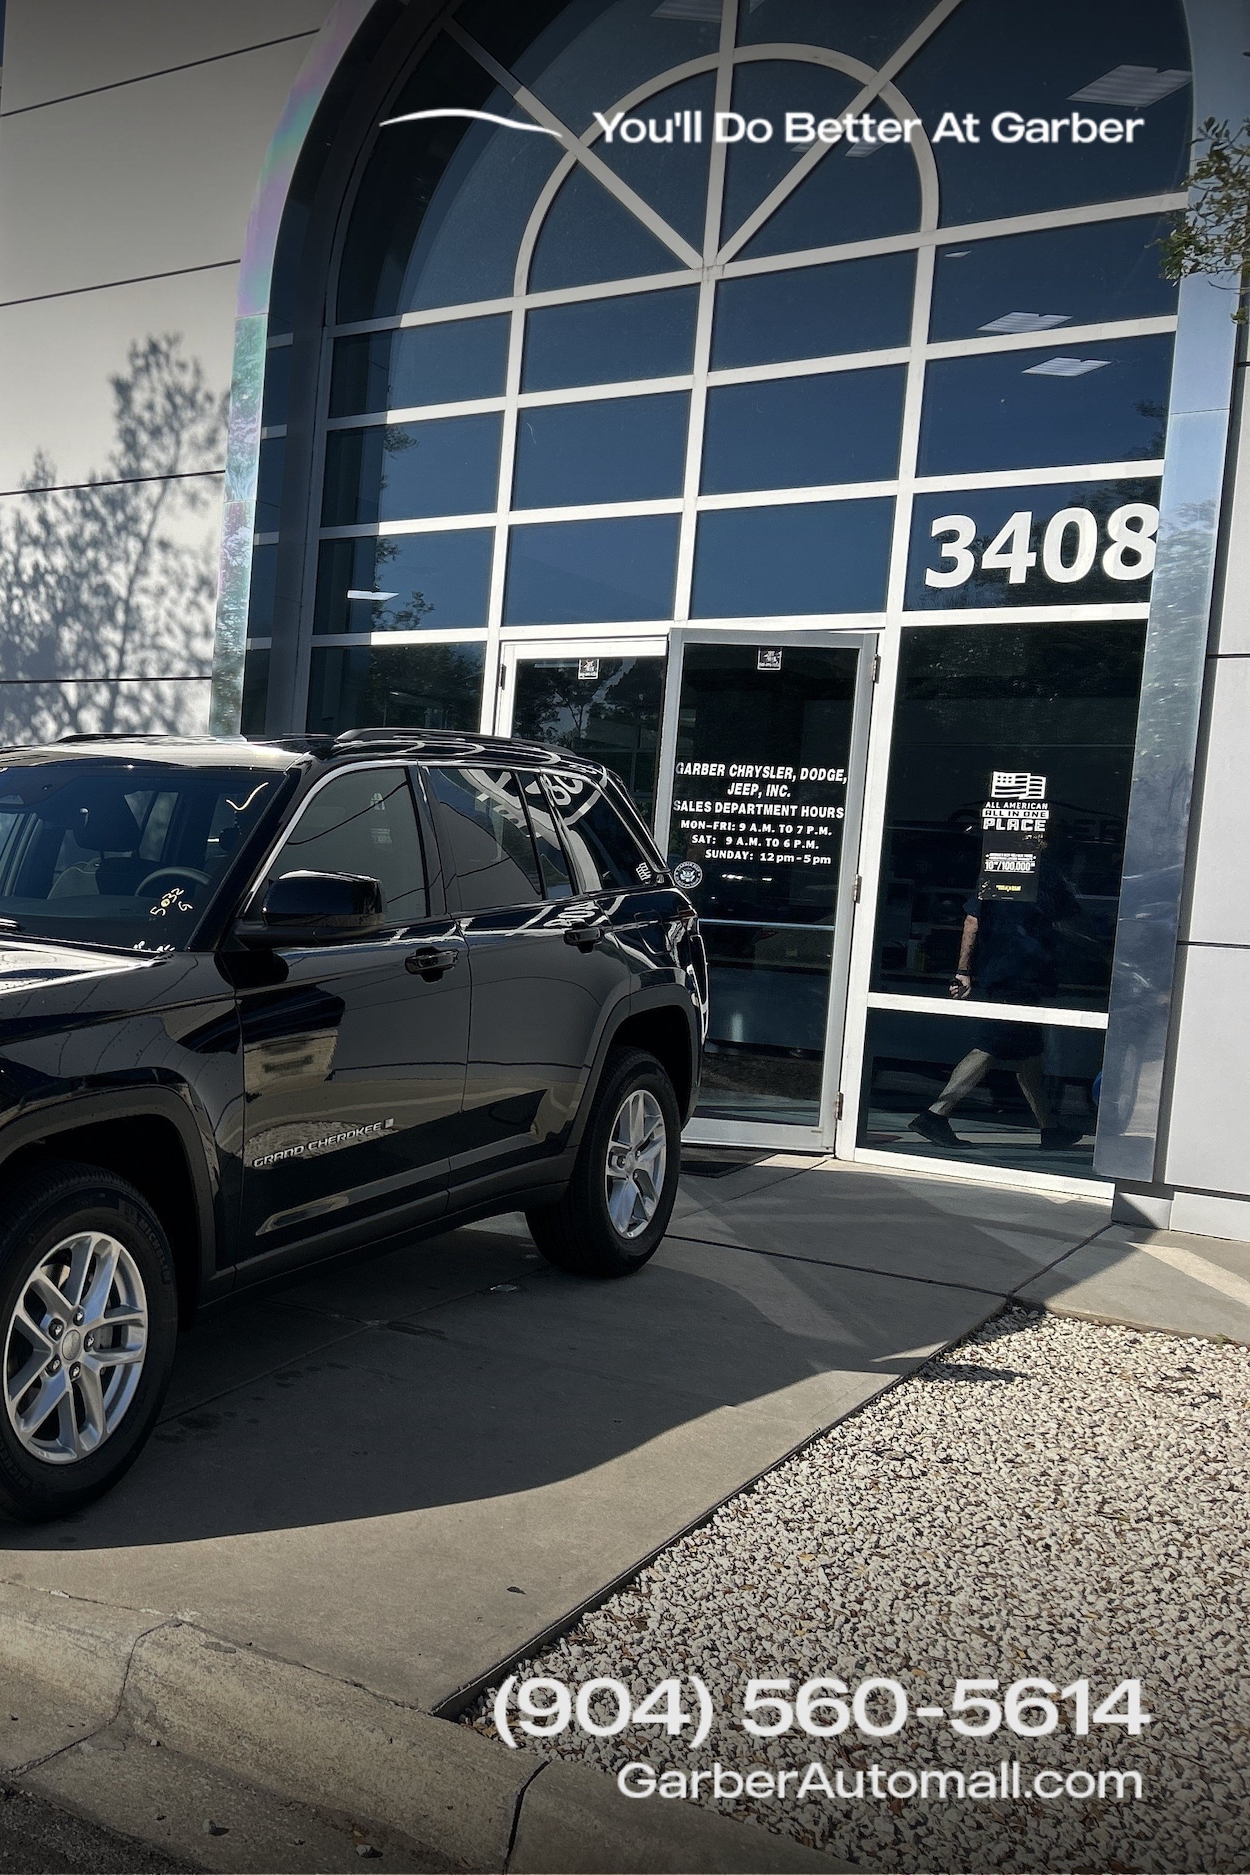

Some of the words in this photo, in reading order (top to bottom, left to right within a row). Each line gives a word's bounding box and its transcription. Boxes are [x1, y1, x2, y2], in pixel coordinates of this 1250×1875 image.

[924, 503, 1160, 588] 3408
[675, 762, 726, 777] GARBER
[729, 764, 797, 782] CHRYSLER,
[800, 768, 848, 785] DODGE,
[727, 783, 763, 798] JEEP,
[766, 784, 791, 797] INC.
[673, 800, 712, 813] SALES
[714, 802, 798, 817] DEPARTMENT
[801, 805, 845, 819] HOURS
[985, 801, 1000, 809] ALL
[1003, 802, 1048, 810] AMERICAN
[738, 823, 747, 832] 9
[749, 823, 775, 833] A.M.
[779, 825, 793, 834] TO
[796, 826, 804, 835] 7
[806, 826, 832, 836] P.M.
[983, 818, 1046, 831] PLACE
[691, 835, 716, 845] SAT:
[725, 837, 733, 845] 9
[736, 837, 762, 847] A.M.
[765, 838, 780, 847] TO
[783, 839, 791, 848] 6
[794, 840, 819, 850] P.M.
[705, 850, 754, 860] SUNDAY:
[150, 888, 185, 916] 5032
[253, 1145, 305, 1168] GRAND
[307, 1121, 382, 1151] CHEROKEE
